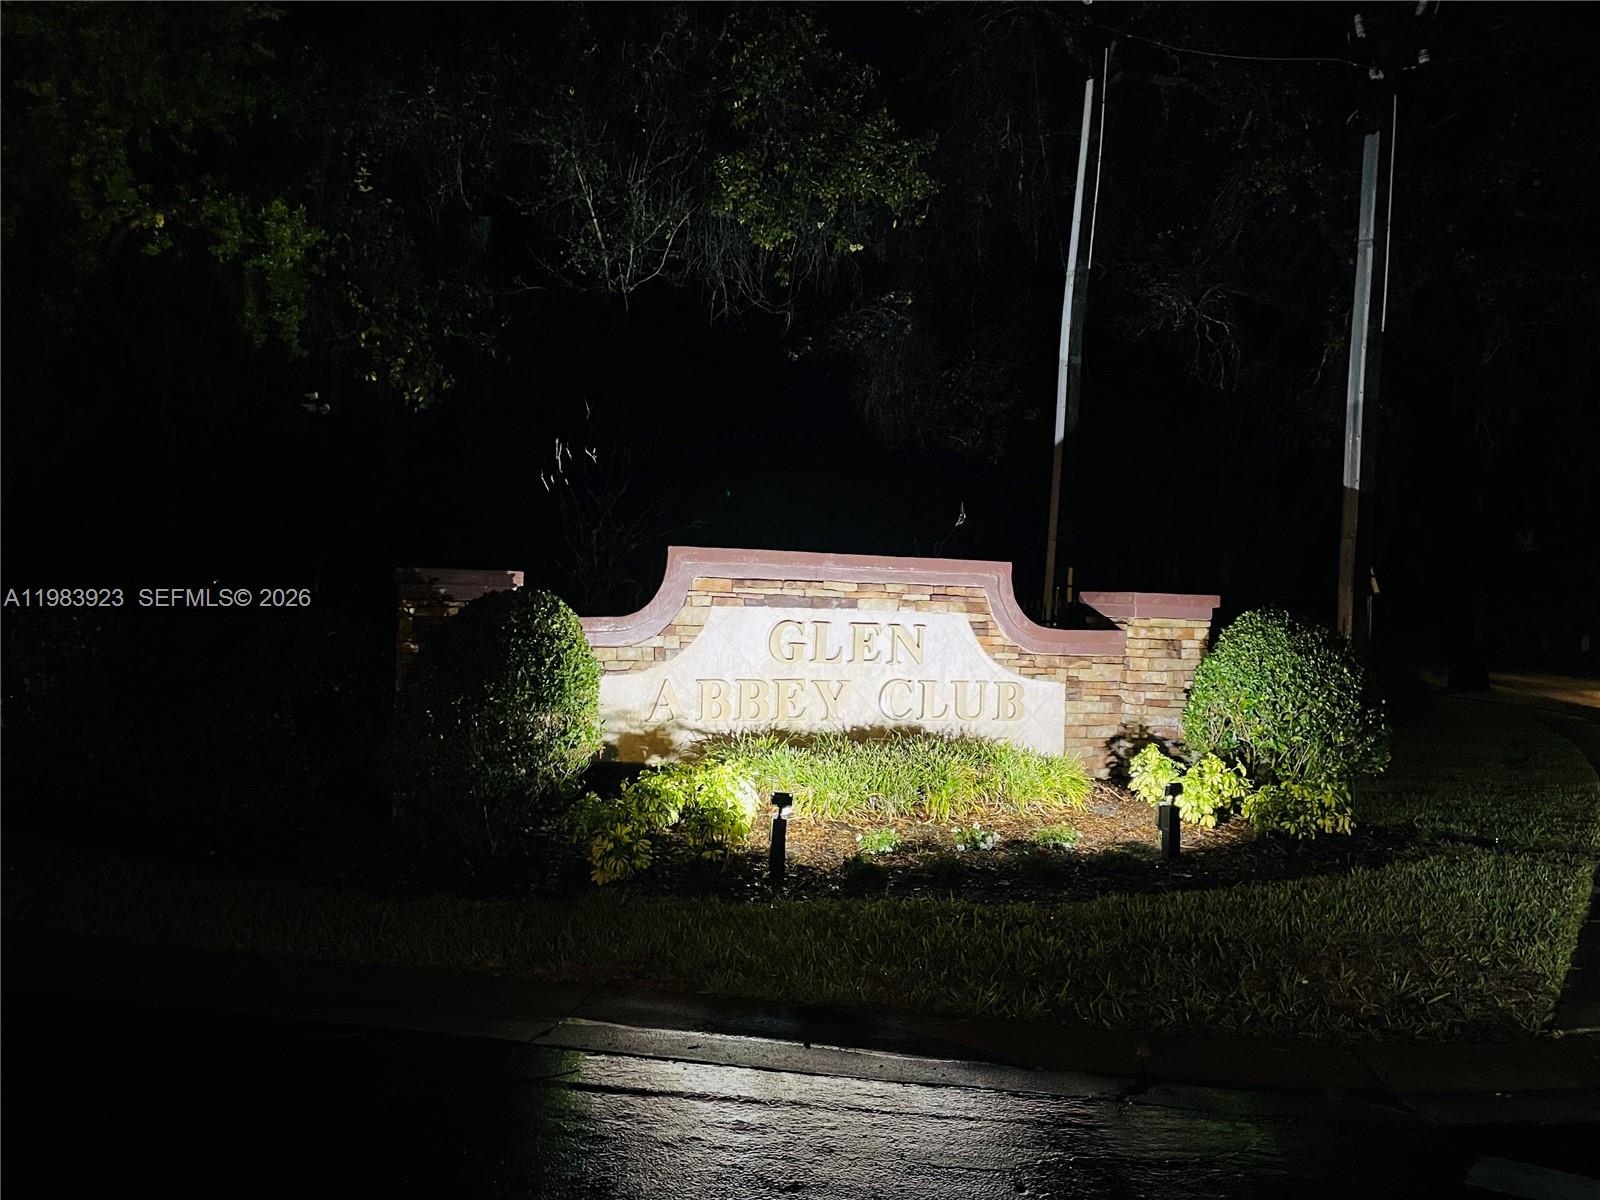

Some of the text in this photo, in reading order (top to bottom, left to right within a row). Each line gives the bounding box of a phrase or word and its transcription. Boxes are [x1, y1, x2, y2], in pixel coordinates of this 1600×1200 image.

[768, 619, 928, 666] GLEN
[646, 677, 1026, 723] ABBEY CLUB
